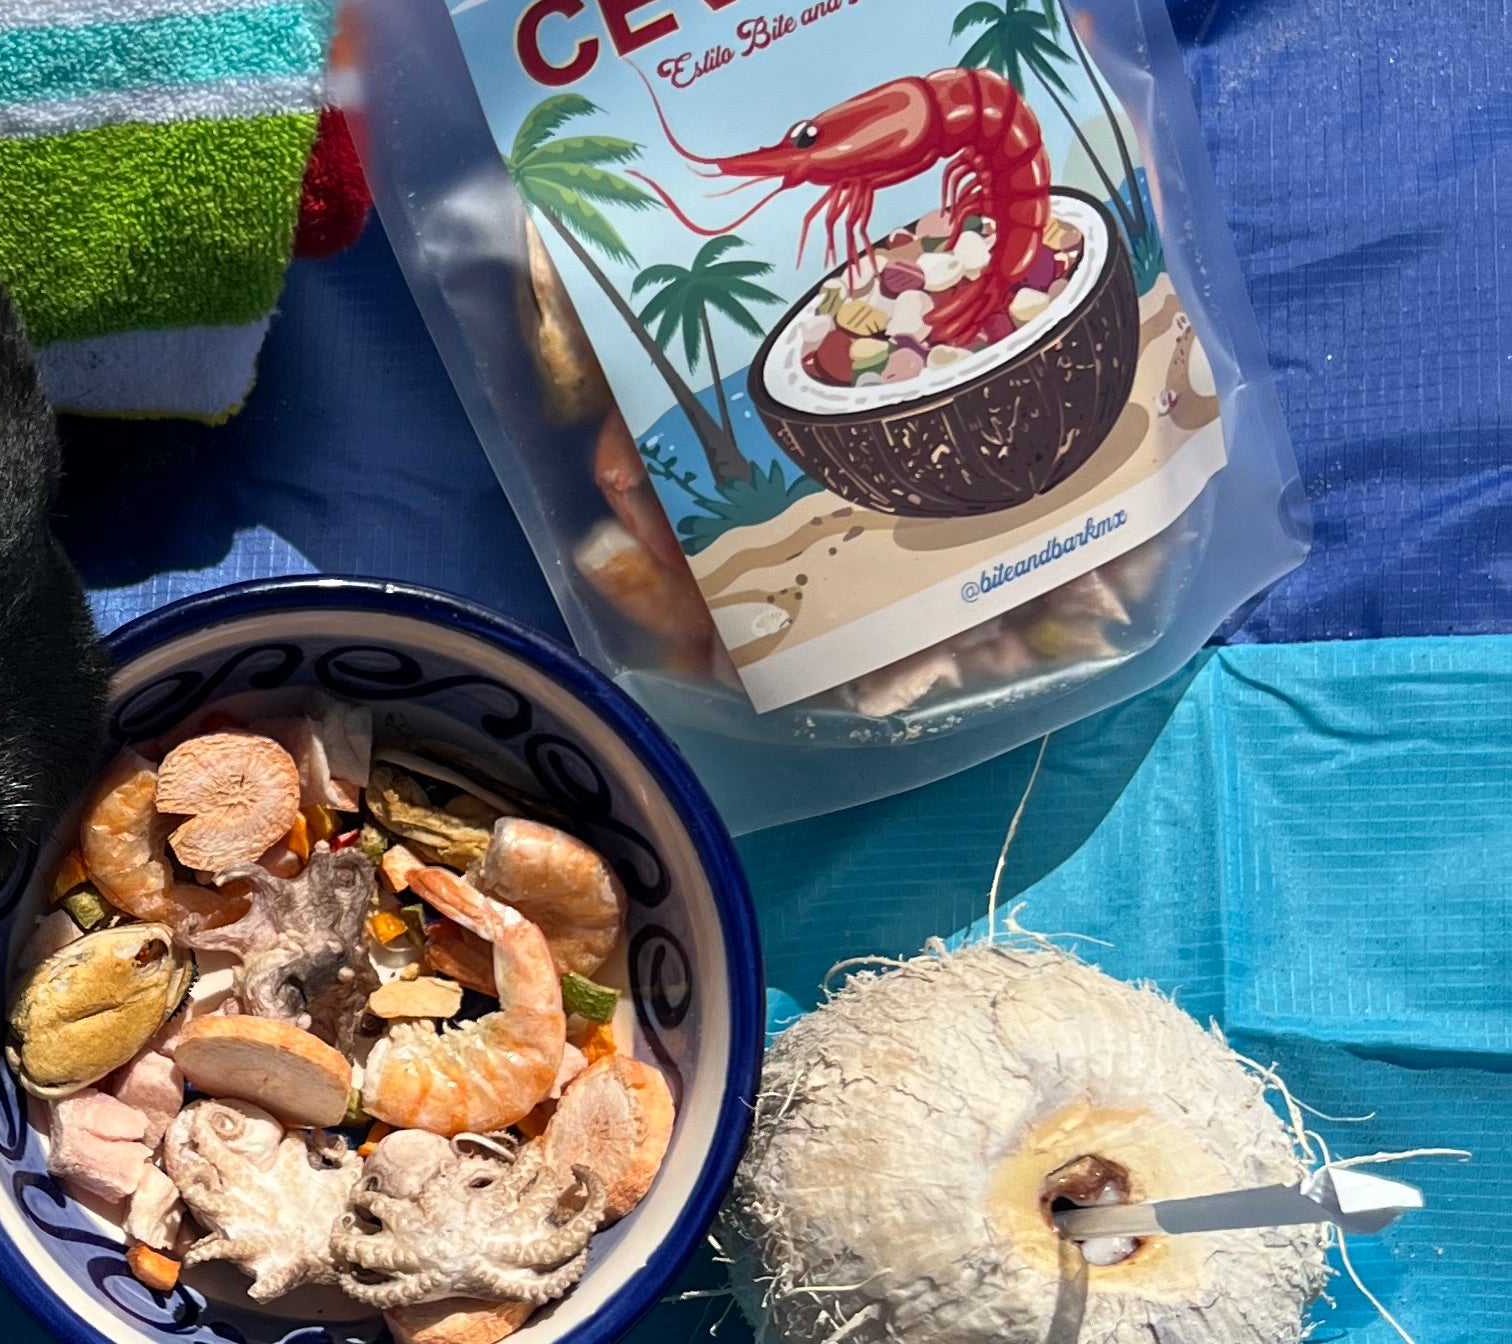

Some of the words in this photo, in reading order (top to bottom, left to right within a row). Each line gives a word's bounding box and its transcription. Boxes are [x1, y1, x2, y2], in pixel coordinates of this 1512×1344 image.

[656, 47, 735, 89] Estilo
[736, 14, 798, 57] Bite
[961, 509, 1128, 603] @biteandbarkmx
